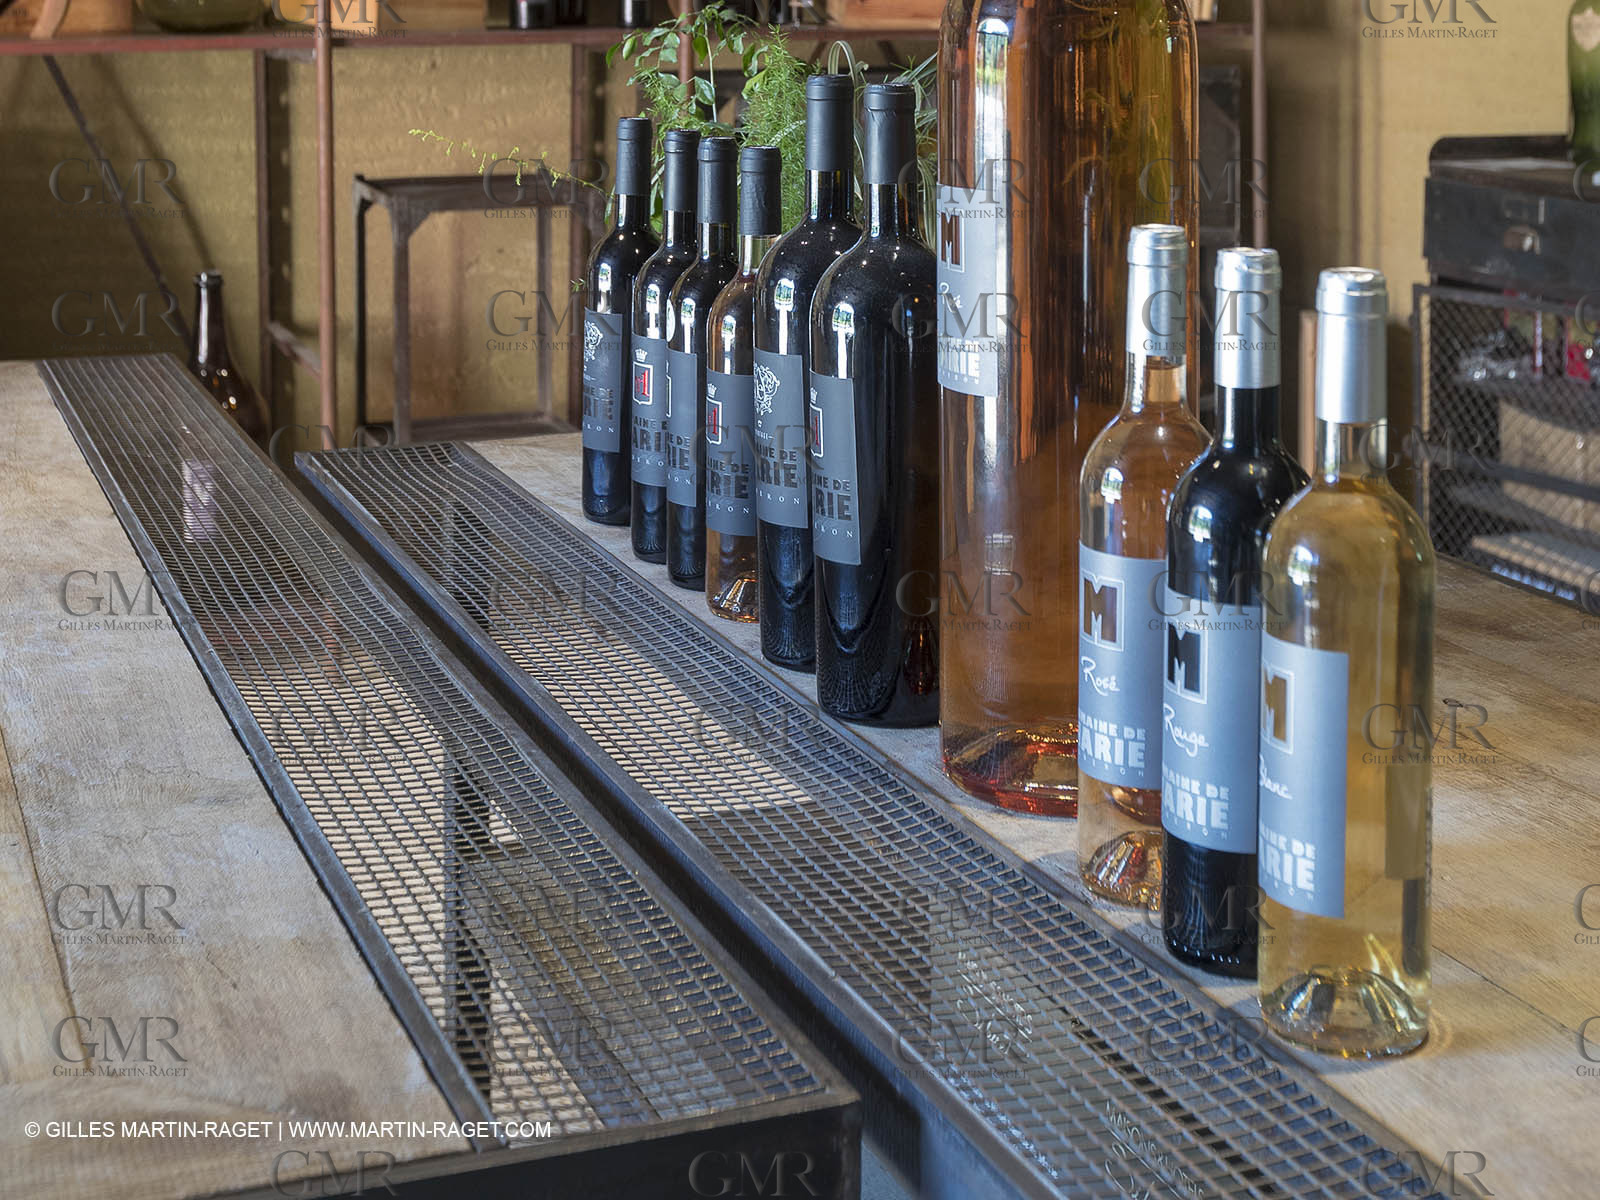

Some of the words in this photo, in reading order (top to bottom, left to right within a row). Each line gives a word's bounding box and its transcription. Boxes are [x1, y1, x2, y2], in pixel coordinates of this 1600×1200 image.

[1081, 655, 1121, 697] Rosé
[1123, 726, 1146, 742] DE
[1163, 702, 1210, 758] Rouge
[1205, 784, 1230, 801] DE
[1291, 838, 1316, 860] DE
